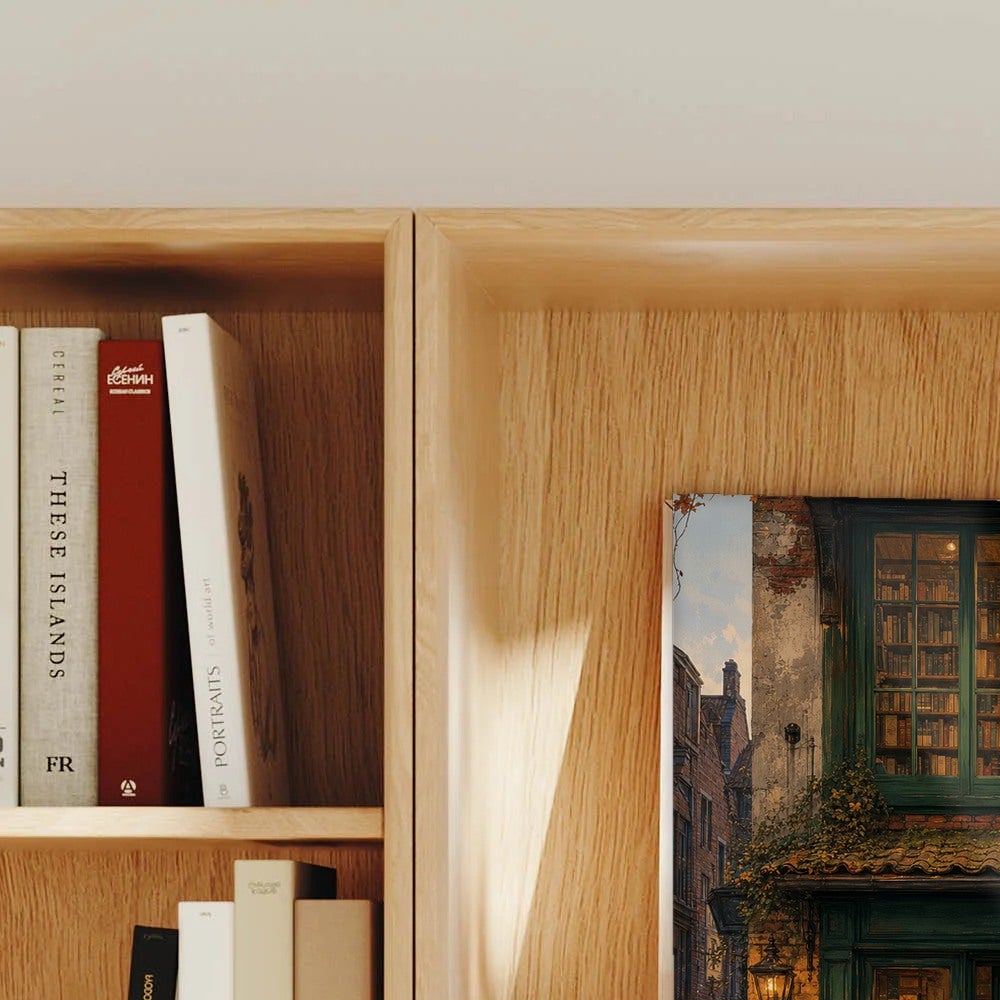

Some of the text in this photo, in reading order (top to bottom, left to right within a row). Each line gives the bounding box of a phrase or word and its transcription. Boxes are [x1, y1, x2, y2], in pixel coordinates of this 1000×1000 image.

[52, 350, 65, 416] CEREAL
[107, 373, 154, 385] ЕСЕНИН
[49, 471, 67, 679] THESE ISLANDS
[208, 665, 228, 768] PORTRAITS
[46, 756, 75, 773] FR
